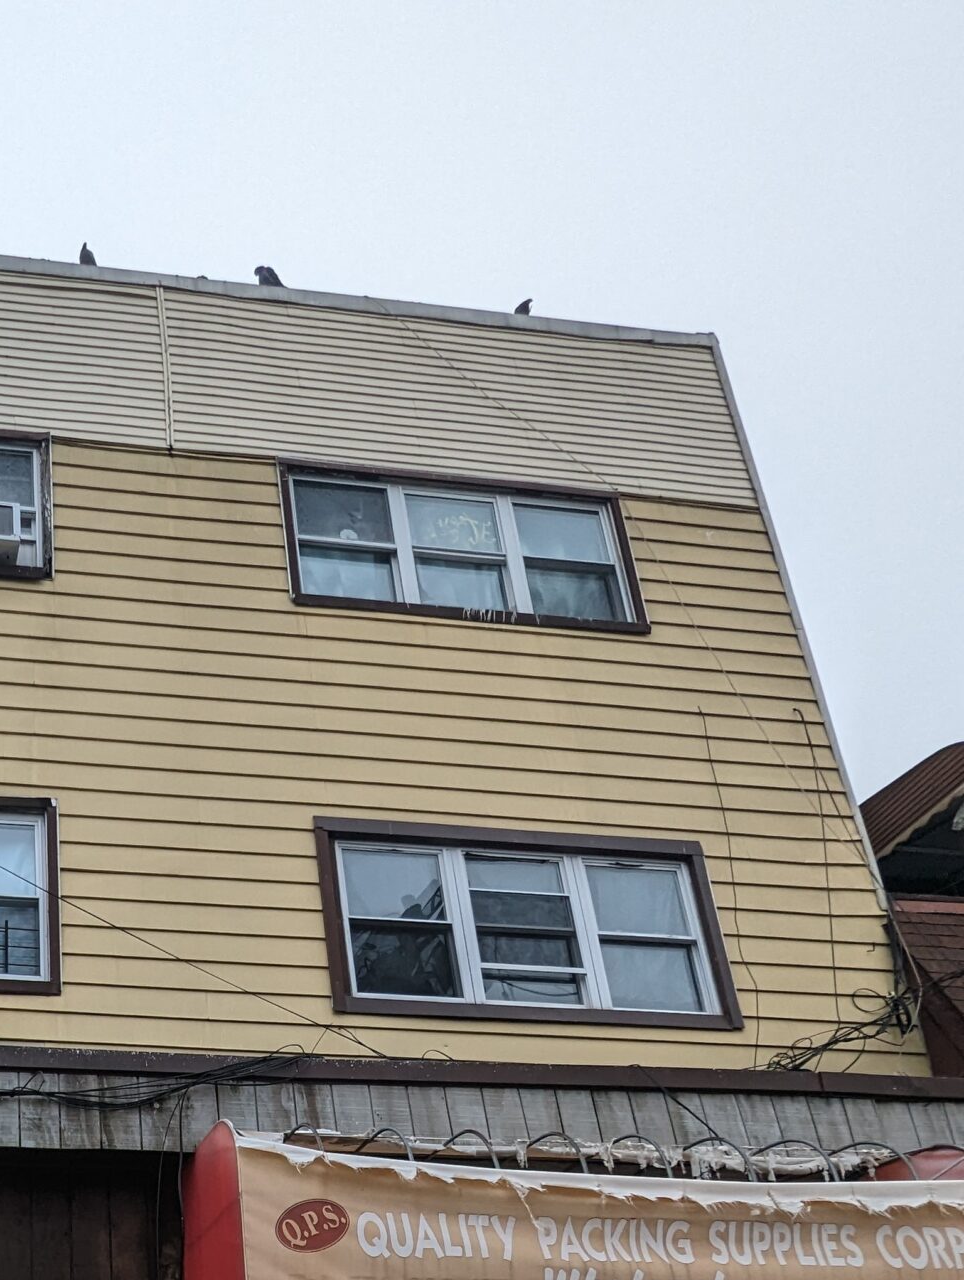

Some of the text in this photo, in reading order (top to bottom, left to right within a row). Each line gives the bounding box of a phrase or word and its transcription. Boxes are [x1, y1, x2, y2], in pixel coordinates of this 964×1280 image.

[282, 1205, 346, 1248] Q.P.S.
[357, 1211, 516, 1261] QUALITY
[537, 1216, 696, 1264] PACKING
[708, 1220, 864, 1267] SUPPLIES
